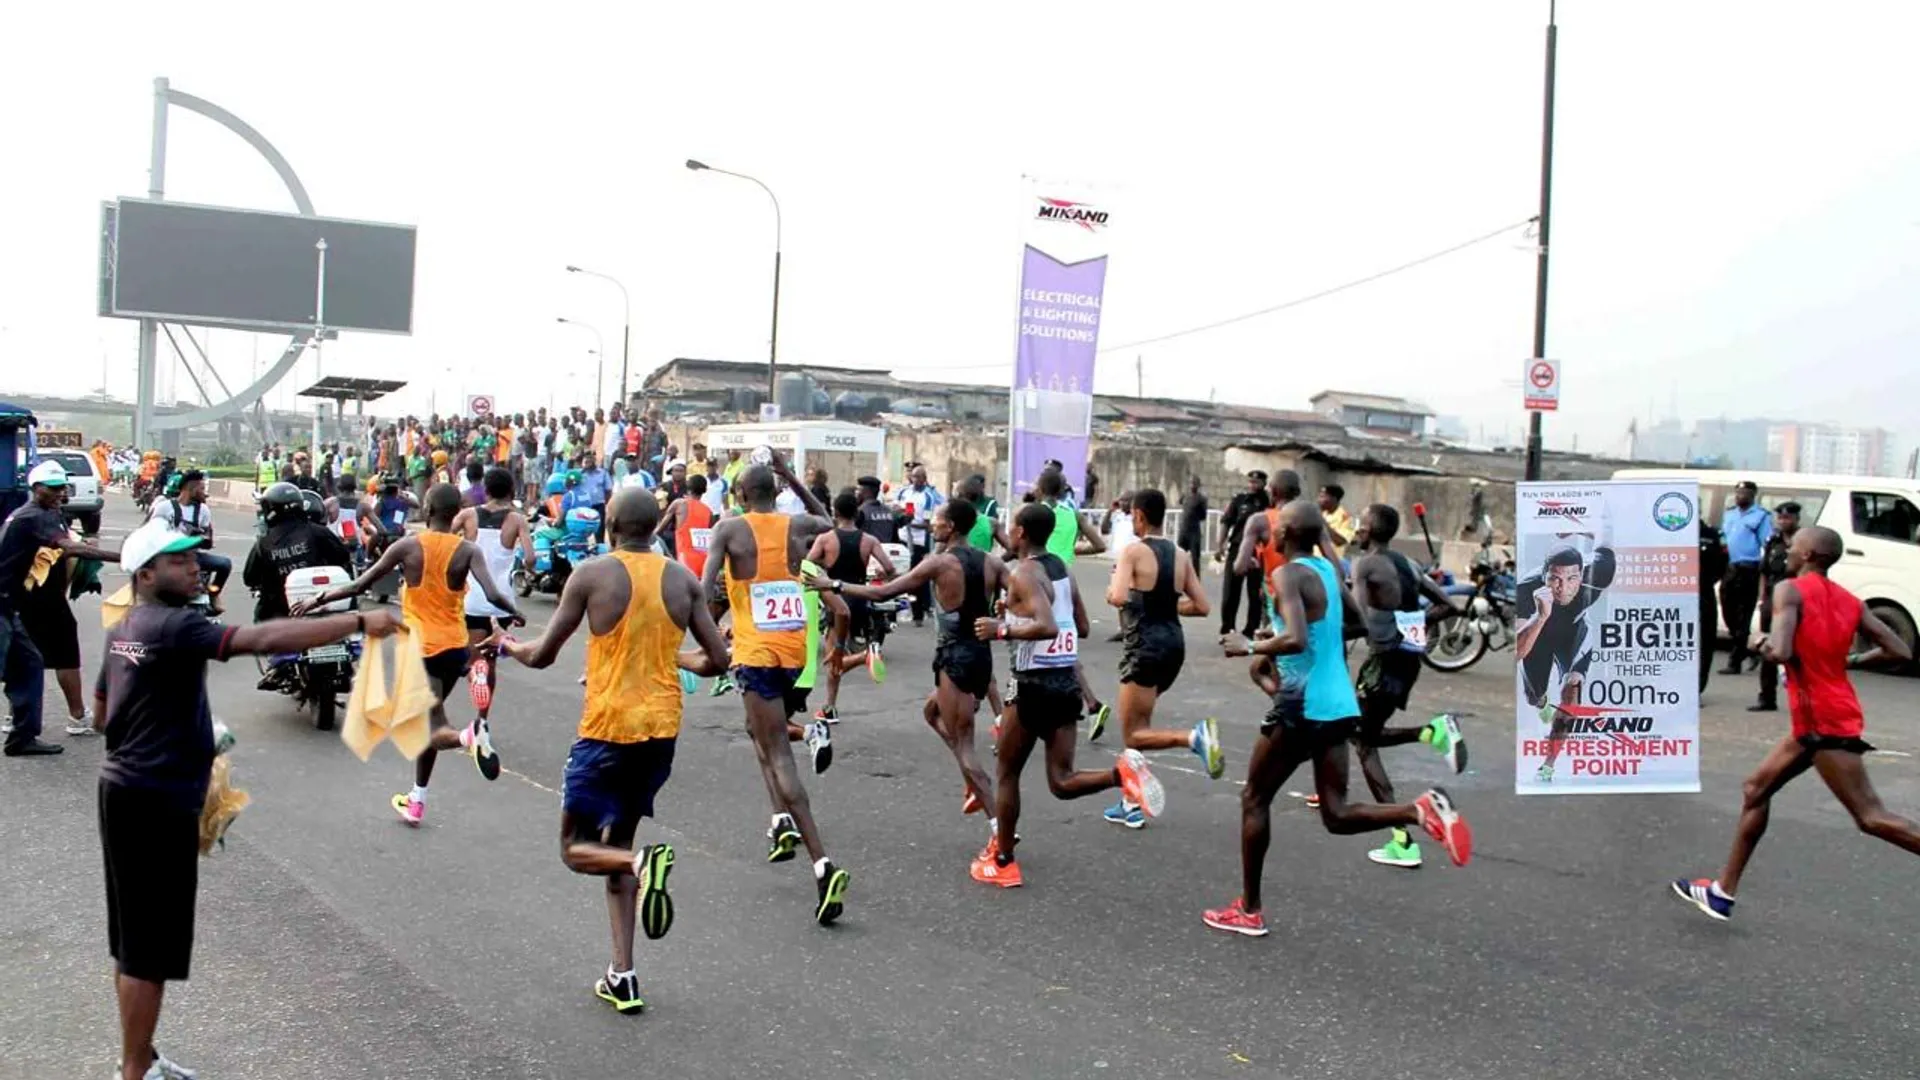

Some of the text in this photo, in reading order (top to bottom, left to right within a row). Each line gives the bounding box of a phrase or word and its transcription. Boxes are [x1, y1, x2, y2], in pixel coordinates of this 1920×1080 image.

[1038, 206, 1109, 224] MIKANO
[1023, 288, 1101, 308] ELECTRICAL
[1033, 308, 1098, 325] LIGHTING
[1022, 323, 1095, 342] SOLUTIONS
[825, 436, 857, 447] POLICE
[1538, 506, 1587, 516] MIKANO
[271, 541, 308, 560] POLICE
[1615, 553, 1687, 562] ONELAGOS
[1615, 565, 1678, 574] ONERACE
[766, 597, 803, 620] 240
[1614, 608, 1680, 621] DREAM
[1600, 622, 1694, 648] BIG!!!
[1638, 650, 1696, 662] ALMOST
[1614, 664, 1662, 676] THERE
[1573, 680, 1680, 705] 100m TO
[1556, 717, 1653, 733] MIKANO
[1523, 739, 1692, 756] REFRESHMENT
[1572, 760, 1642, 775] POINT
